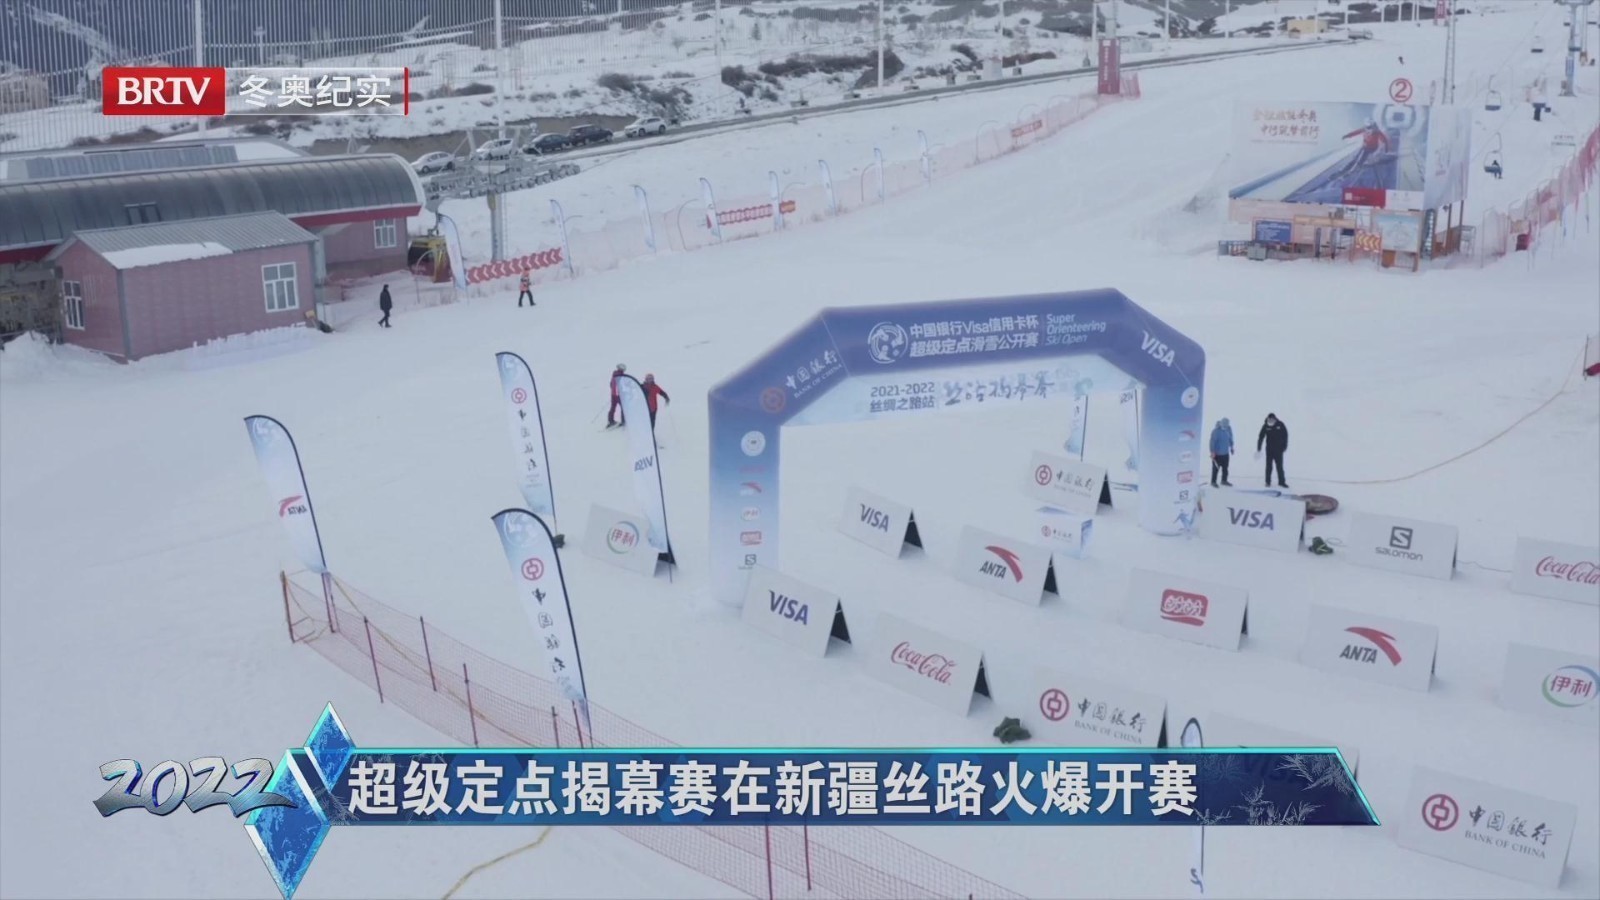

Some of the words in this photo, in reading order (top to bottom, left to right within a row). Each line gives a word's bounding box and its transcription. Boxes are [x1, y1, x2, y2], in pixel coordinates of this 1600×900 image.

[909, 314, 1040, 339] 中国银行Visa信用卡杯
[1046, 313, 1076, 325] Super
[1046, 319, 1107, 335] Orienteering
[908, 331, 1040, 358] 超级定点滑雪公开赛
[1045, 334, 1060, 346] Ski
[1061, 333, 1089, 346] Open
[1140, 329, 1176, 368] VISA
[785, 349, 838, 390] 中国银行
[870, 381, 936, 398] 2021-2022
[869, 394, 936, 413] 丝绸之路站
[859, 502, 890, 533] VISA
[1226, 506, 1275, 531] VISA
[610, 527, 636, 547] 伊利
[1374, 546, 1424, 562] salomon
[978, 559, 1007, 580] ANTA
[1535, 555, 1600, 586] Coca-Cola
[768, 589, 809, 626] VISA
[890, 640, 958, 686] Coca-Cola
[1339, 643, 1379, 665] ANTA
[1550, 674, 1593, 698] 伊利
[1076, 697, 1148, 734] 中国银行
[1073, 718, 1098, 734] BANK
[1099, 726, 1112, 737] OF
[1113, 730, 1143, 745] CHINA
[1468, 804, 1553, 846] 中国银行
[1464, 829, 1493, 846] BANK
[1494, 838, 1509, 850] OF
[1511, 842, 1547, 860] CHINA
